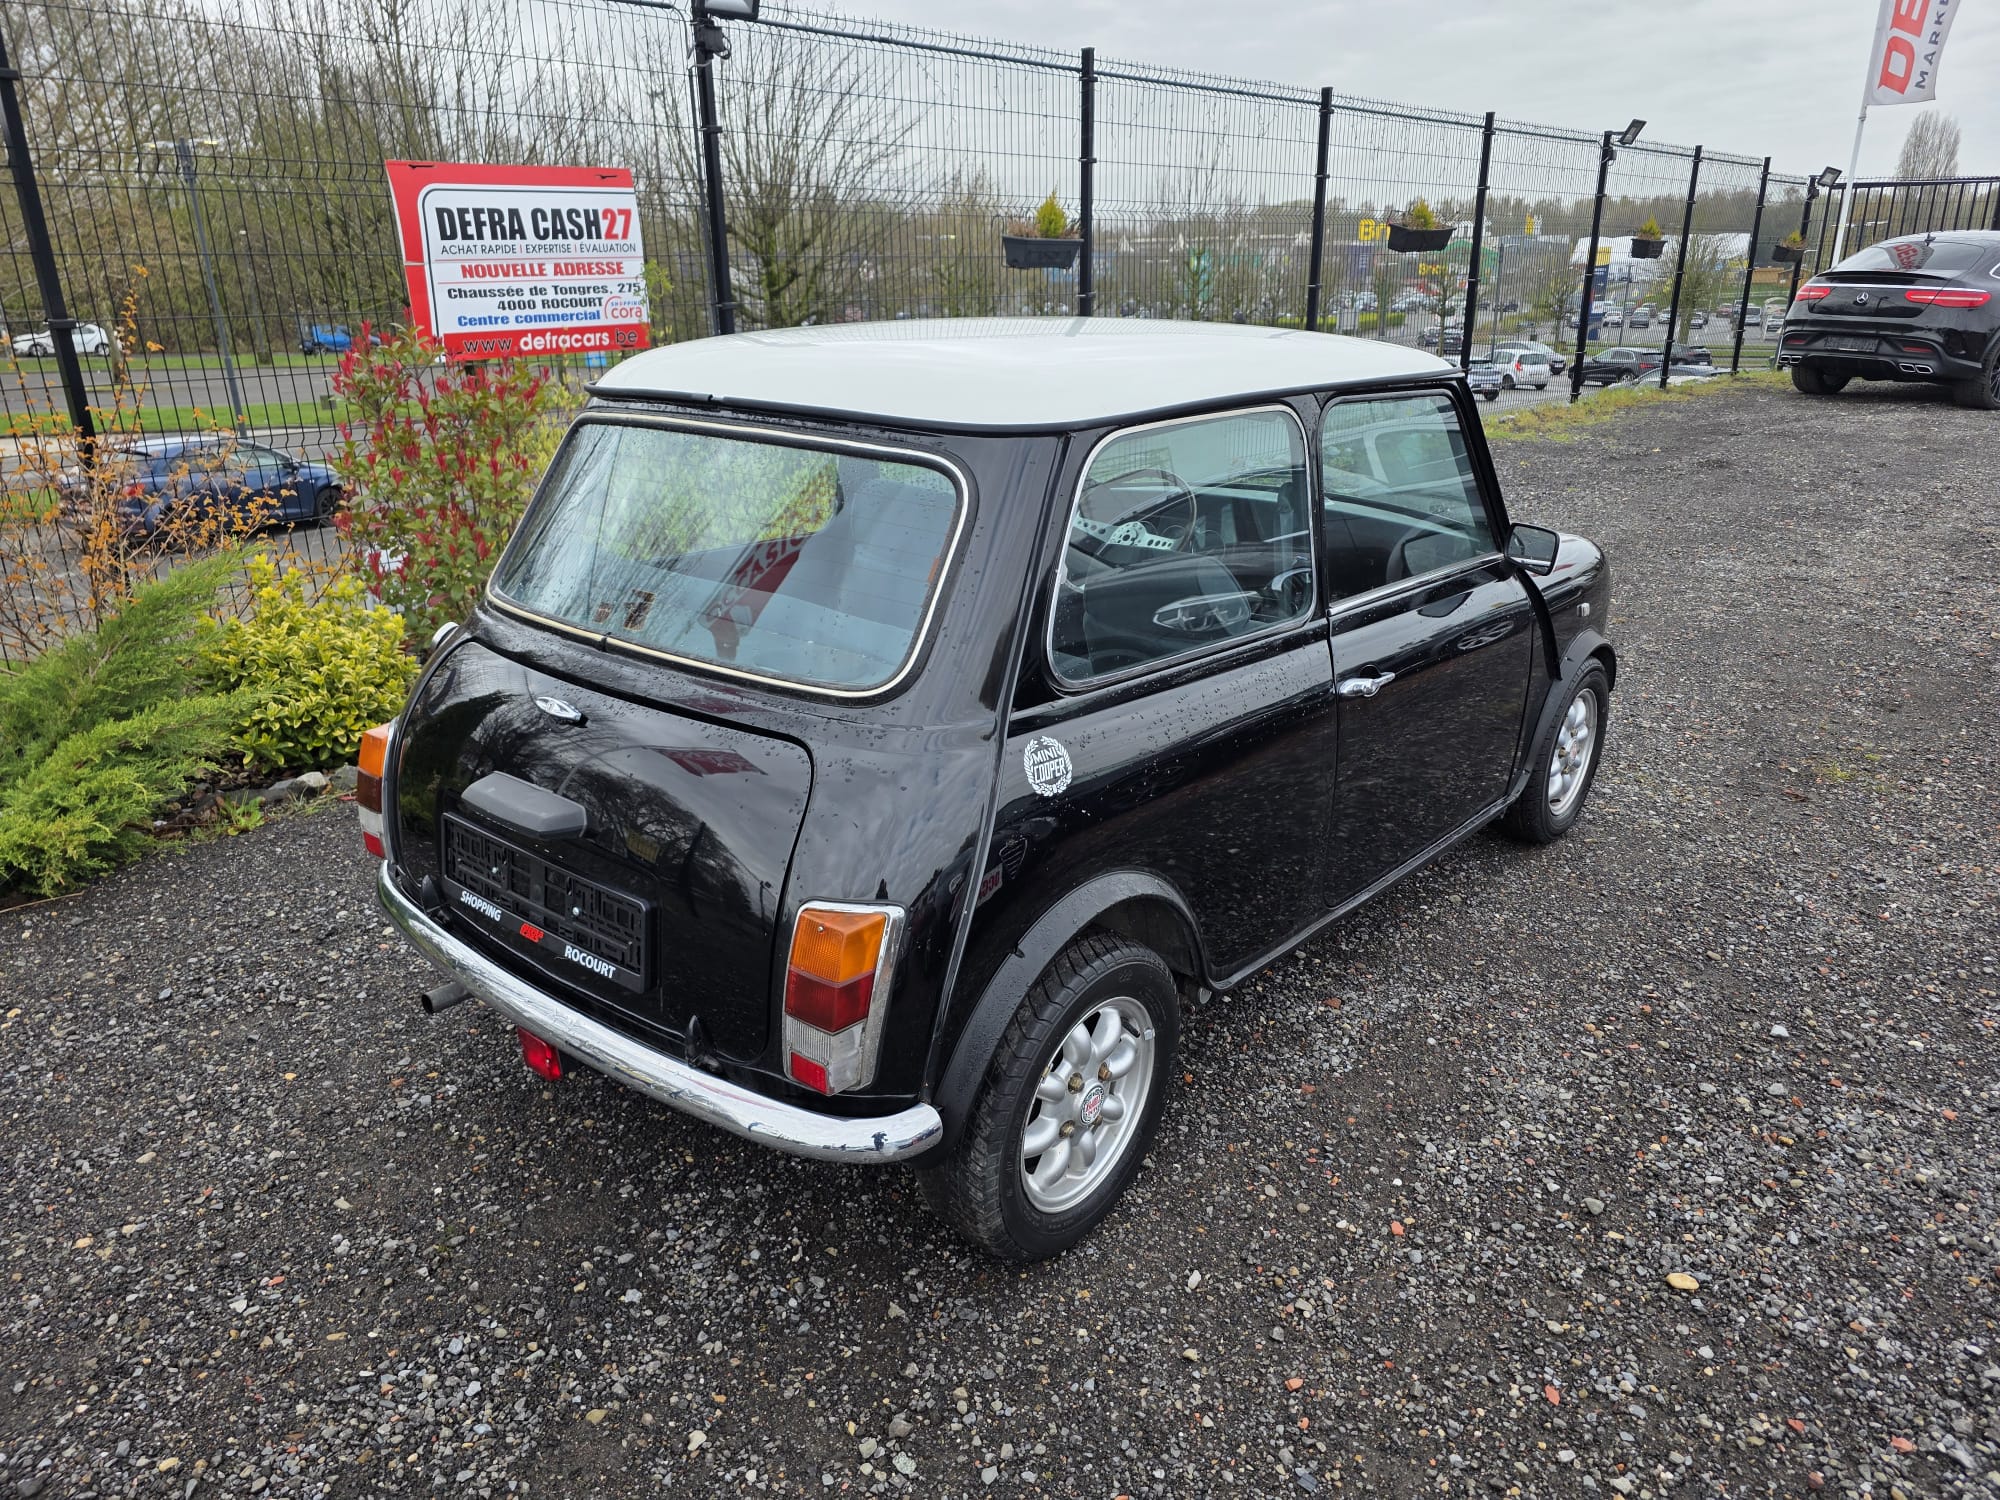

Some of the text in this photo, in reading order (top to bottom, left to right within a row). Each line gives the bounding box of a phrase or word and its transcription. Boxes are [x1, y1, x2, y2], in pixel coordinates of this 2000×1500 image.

[435, 207, 527, 241] DEFRA
[441, 241, 636, 255] ACHAT RAPIDE EXPERTISE ÉVALUATION
[460, 261, 625, 279] NOUVELLE ADRESSE
[447, 286, 524, 299] Chaussée
[529, 285, 548, 297] de
[617, 282, 641, 294] 275
[497, 296, 603, 311] 4000 ROCOURT
[457, 310, 601, 327] Centre commercial
[610, 306, 643, 319] cora
[1030, 746, 1058, 765] MINI
[1033, 757, 1067, 784] COOPER
[460, 890, 617, 979] SHOPPING ROCOURT
